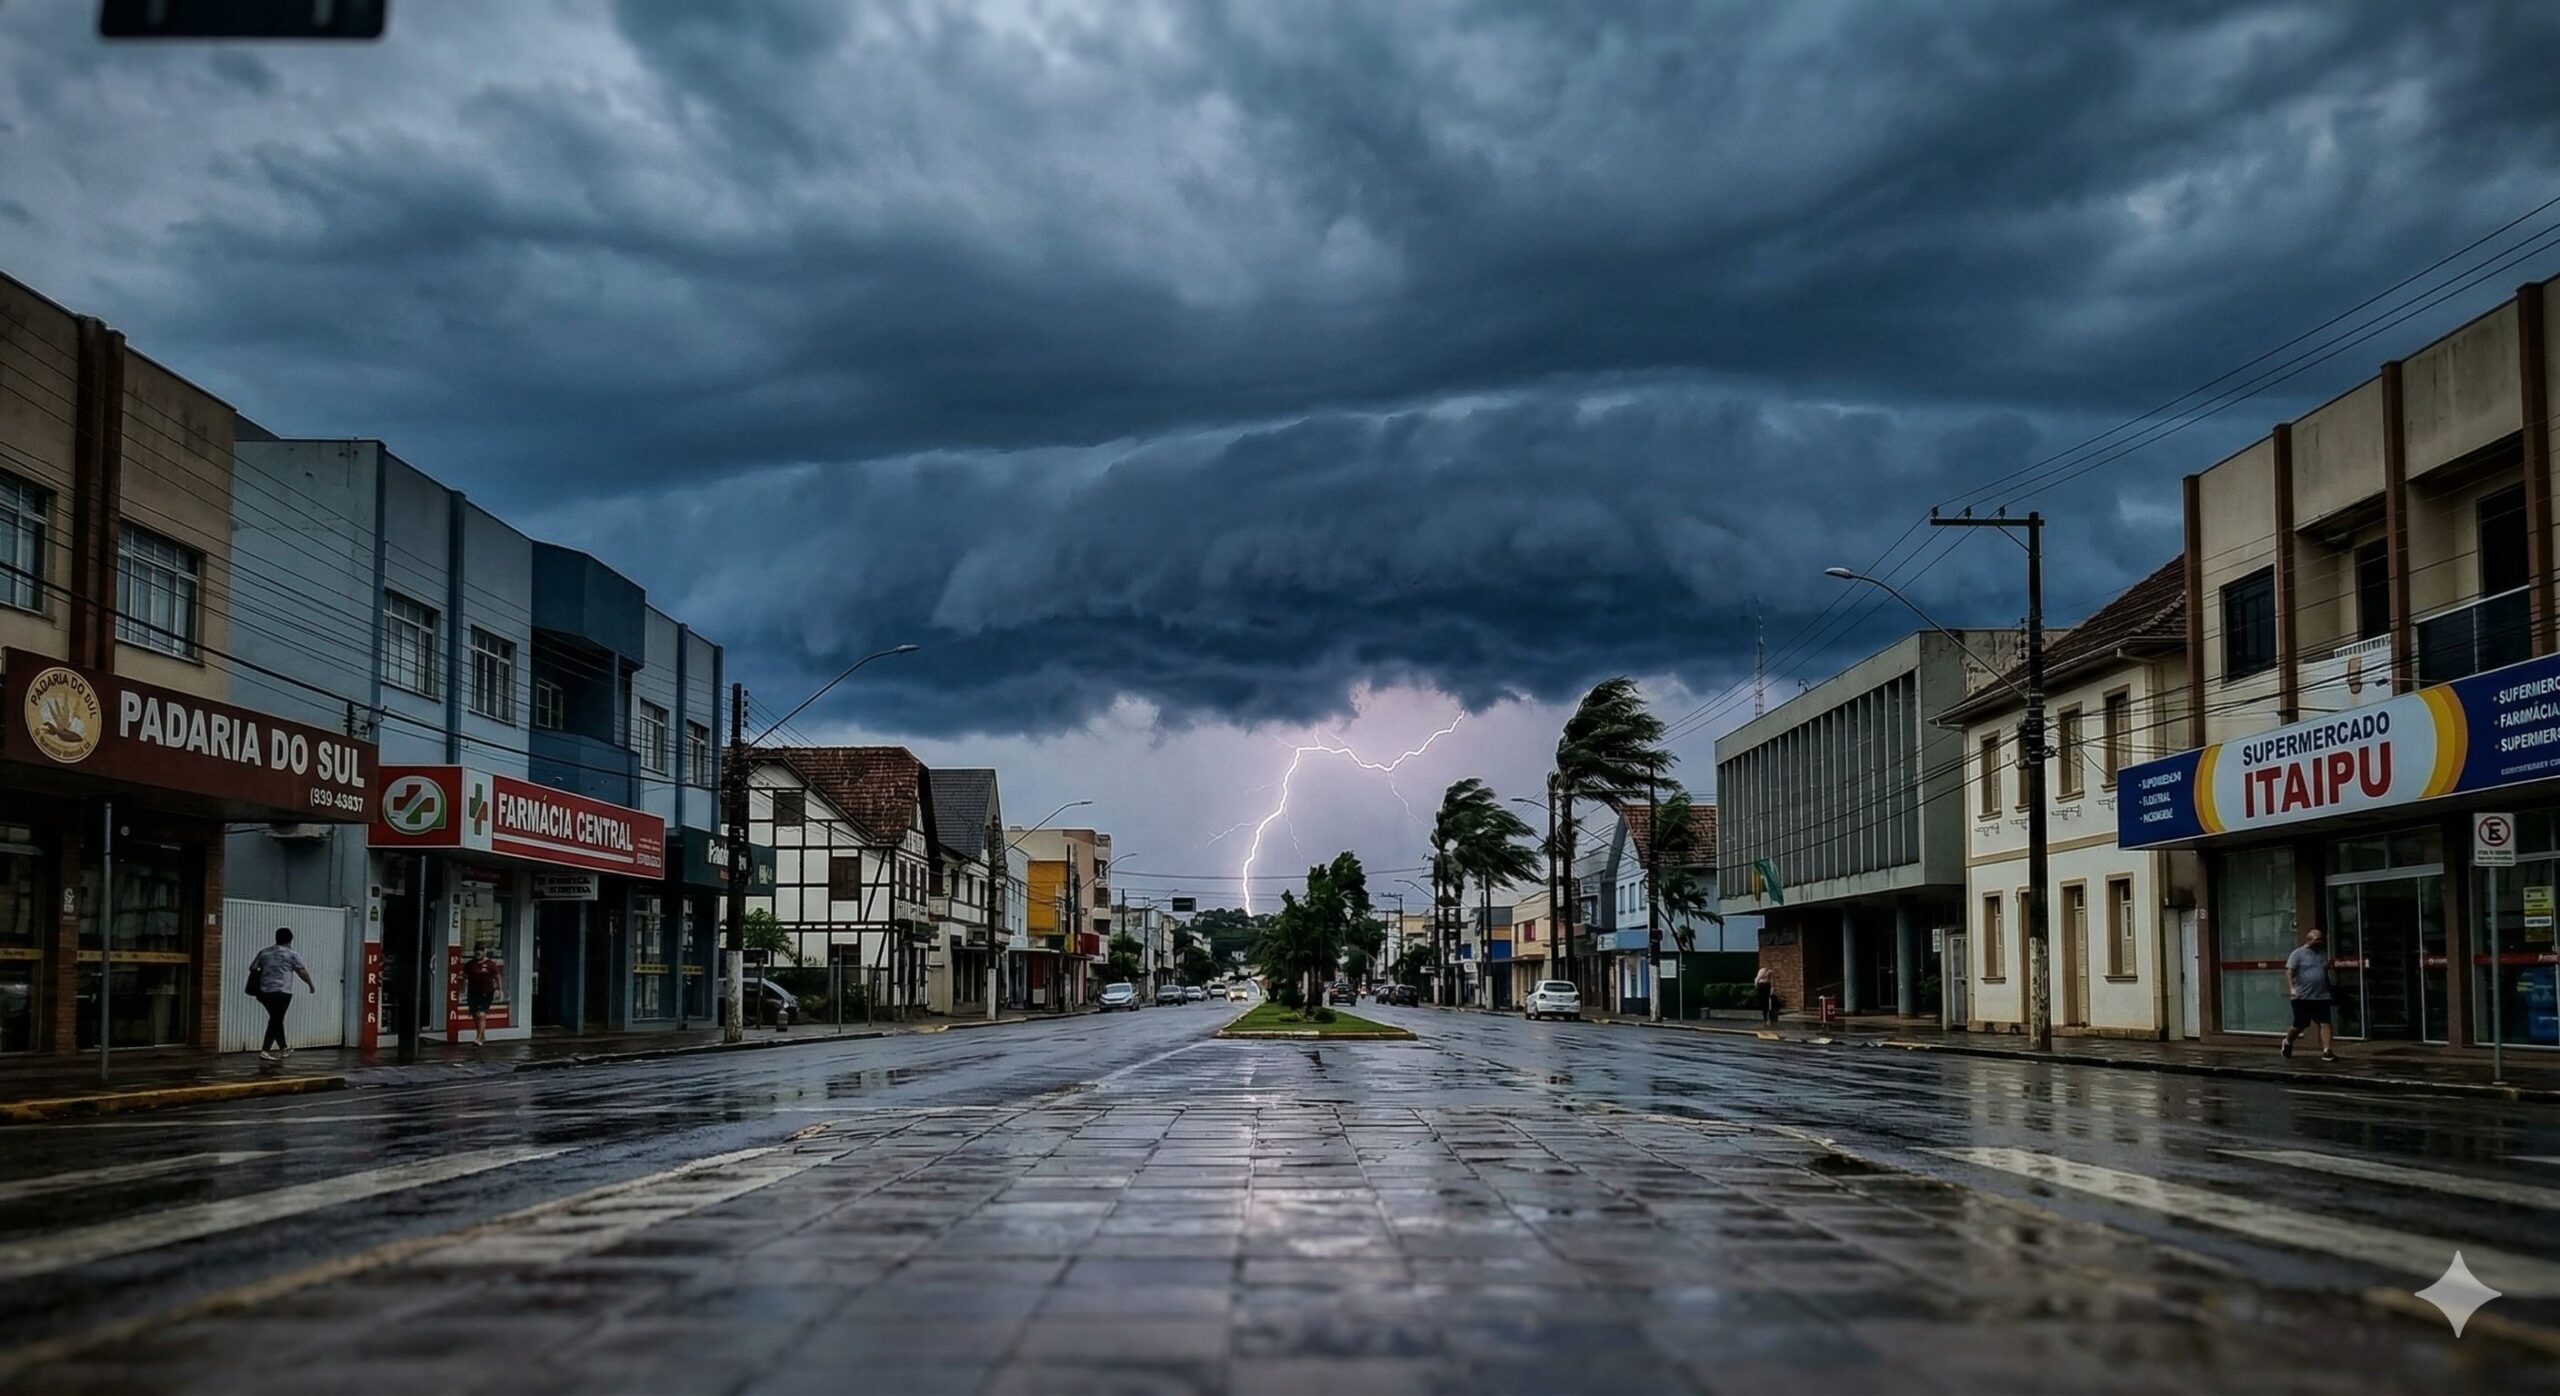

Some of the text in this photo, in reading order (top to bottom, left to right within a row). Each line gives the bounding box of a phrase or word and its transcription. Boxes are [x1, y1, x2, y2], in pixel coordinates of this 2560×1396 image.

[31, 673, 69, 706] PADARIA
[70, 676, 85, 695] DO
[119, 689, 262, 767] PADARIA
[270, 728, 308, 775] DO
[317, 740, 365, 788] SUL
[2243, 711, 2390, 766] SUPERMERCADO
[2244, 741, 2391, 818] ITAIPU
[498, 792, 633, 851] FARMÁCIA CENTRAL
